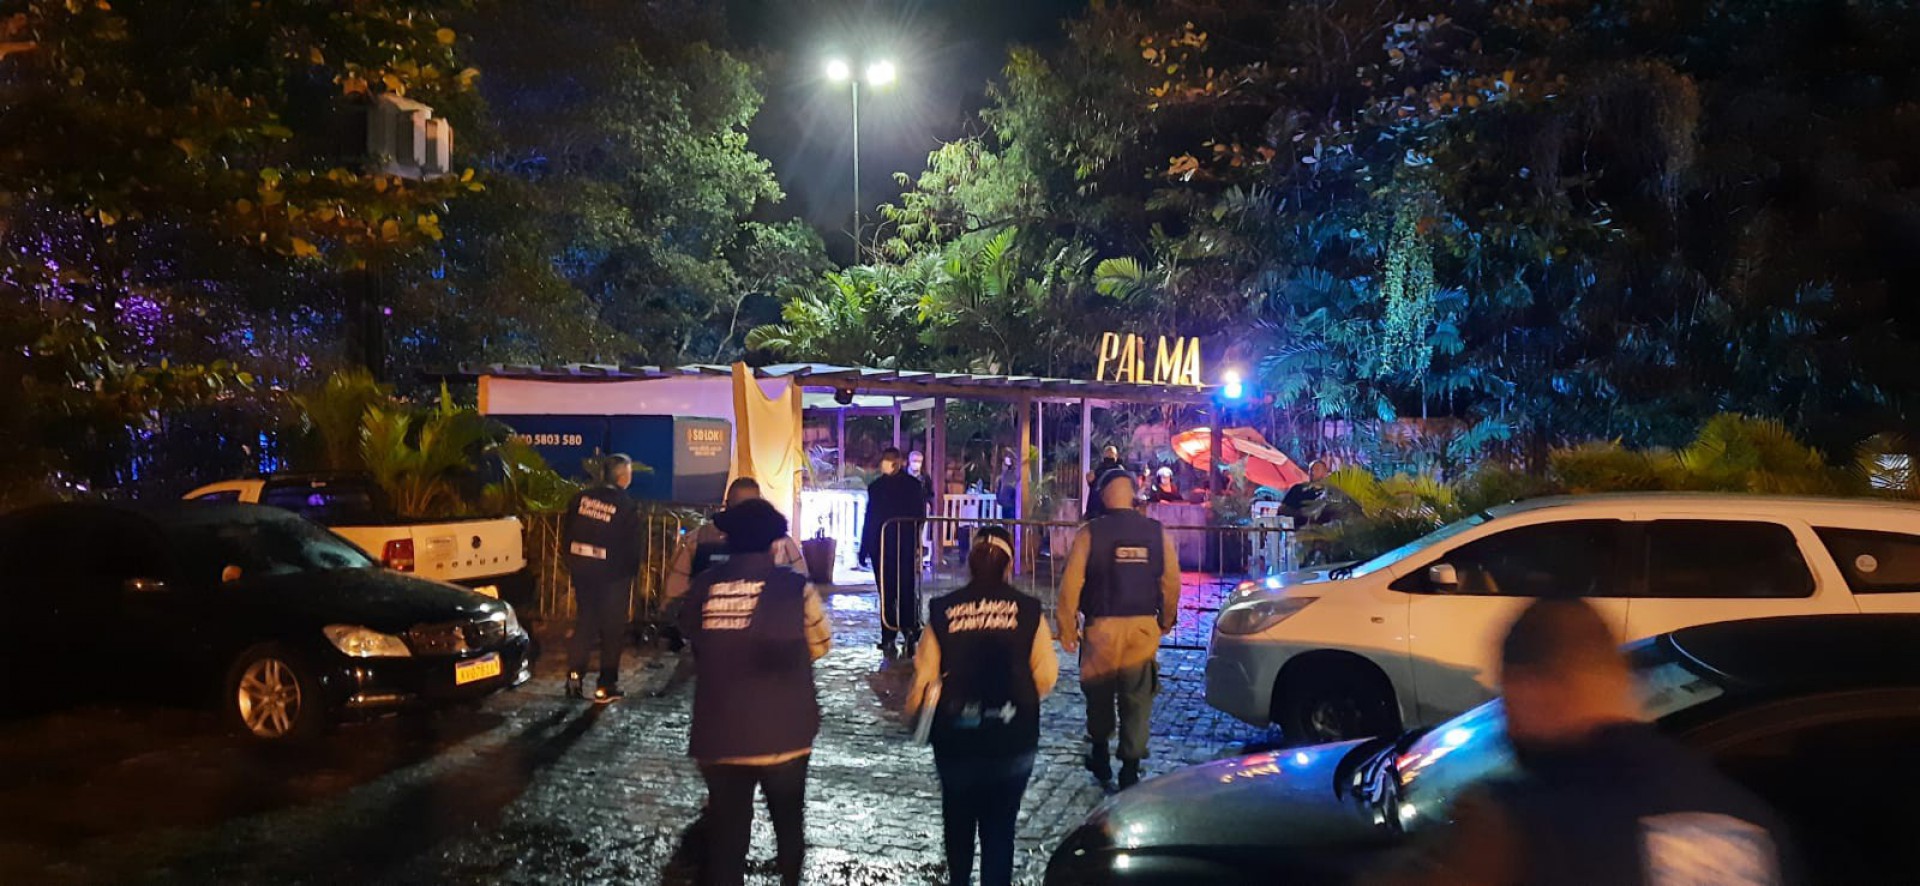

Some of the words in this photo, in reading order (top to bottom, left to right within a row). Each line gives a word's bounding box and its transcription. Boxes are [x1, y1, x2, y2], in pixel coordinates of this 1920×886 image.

[1096, 331, 1200, 385] PALMA
[534, 434, 560, 445] 5803
[562, 434, 582, 445] 580
[945, 597, 1018, 620] VIGILÂNCIA
[948, 612, 1018, 634] SANITÁRIA
